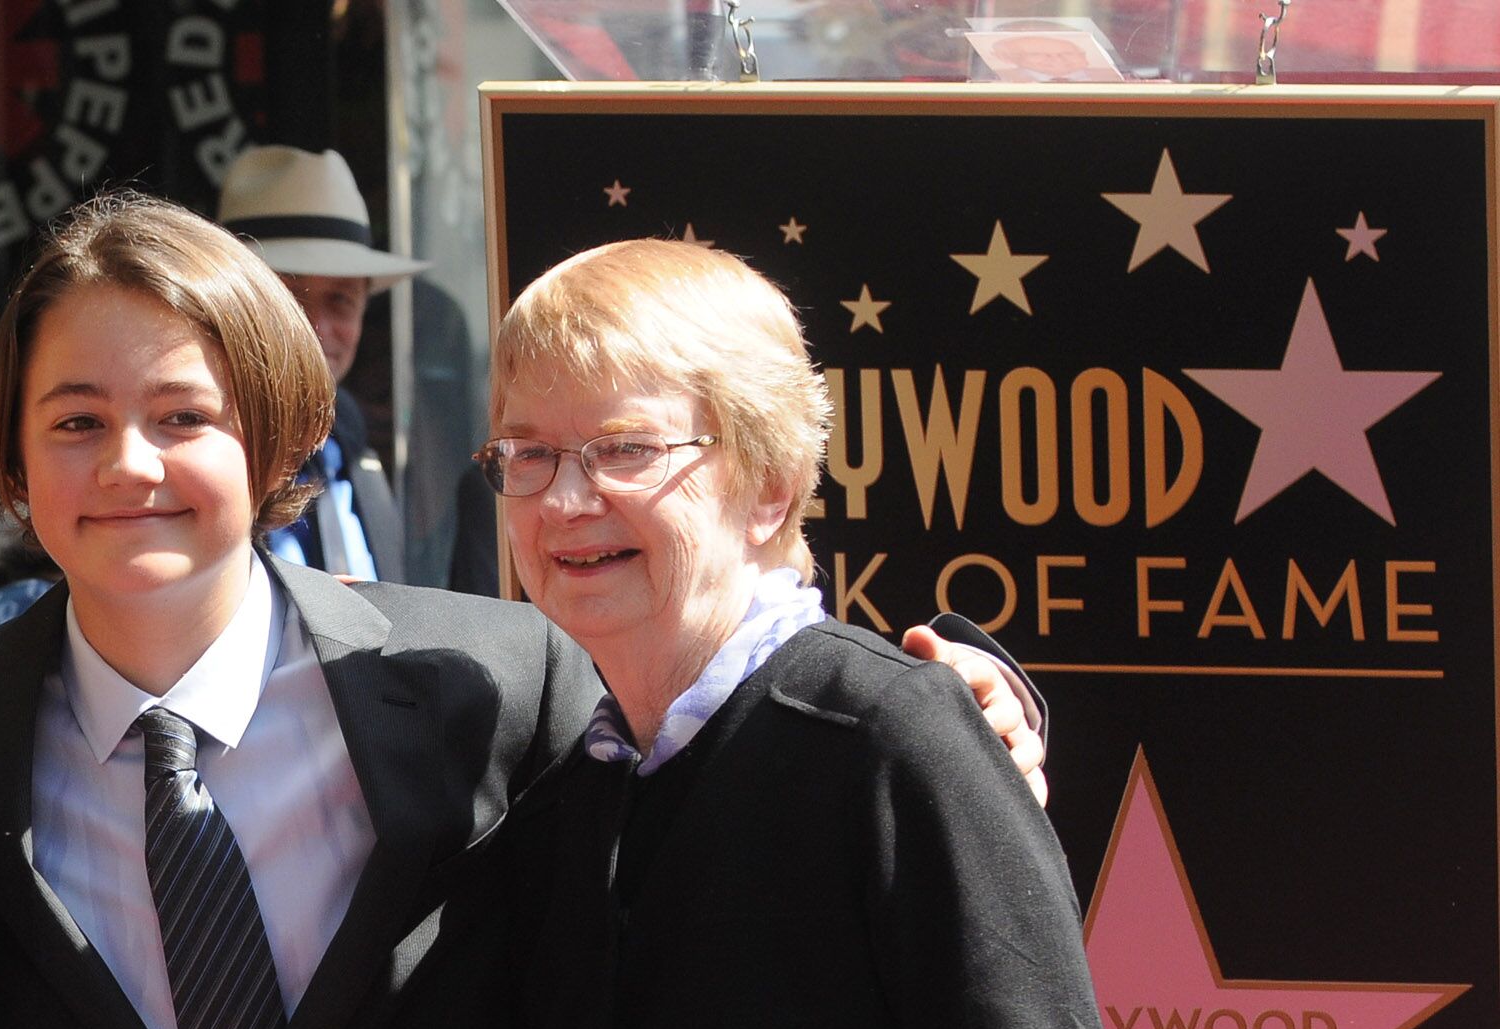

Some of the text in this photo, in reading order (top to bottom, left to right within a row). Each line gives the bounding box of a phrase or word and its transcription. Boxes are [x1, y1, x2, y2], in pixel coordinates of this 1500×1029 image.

[804, 362, 1203, 531] YWOOD
[935, 553, 1087, 637] OF
[1135, 556, 1440, 643] FAME
